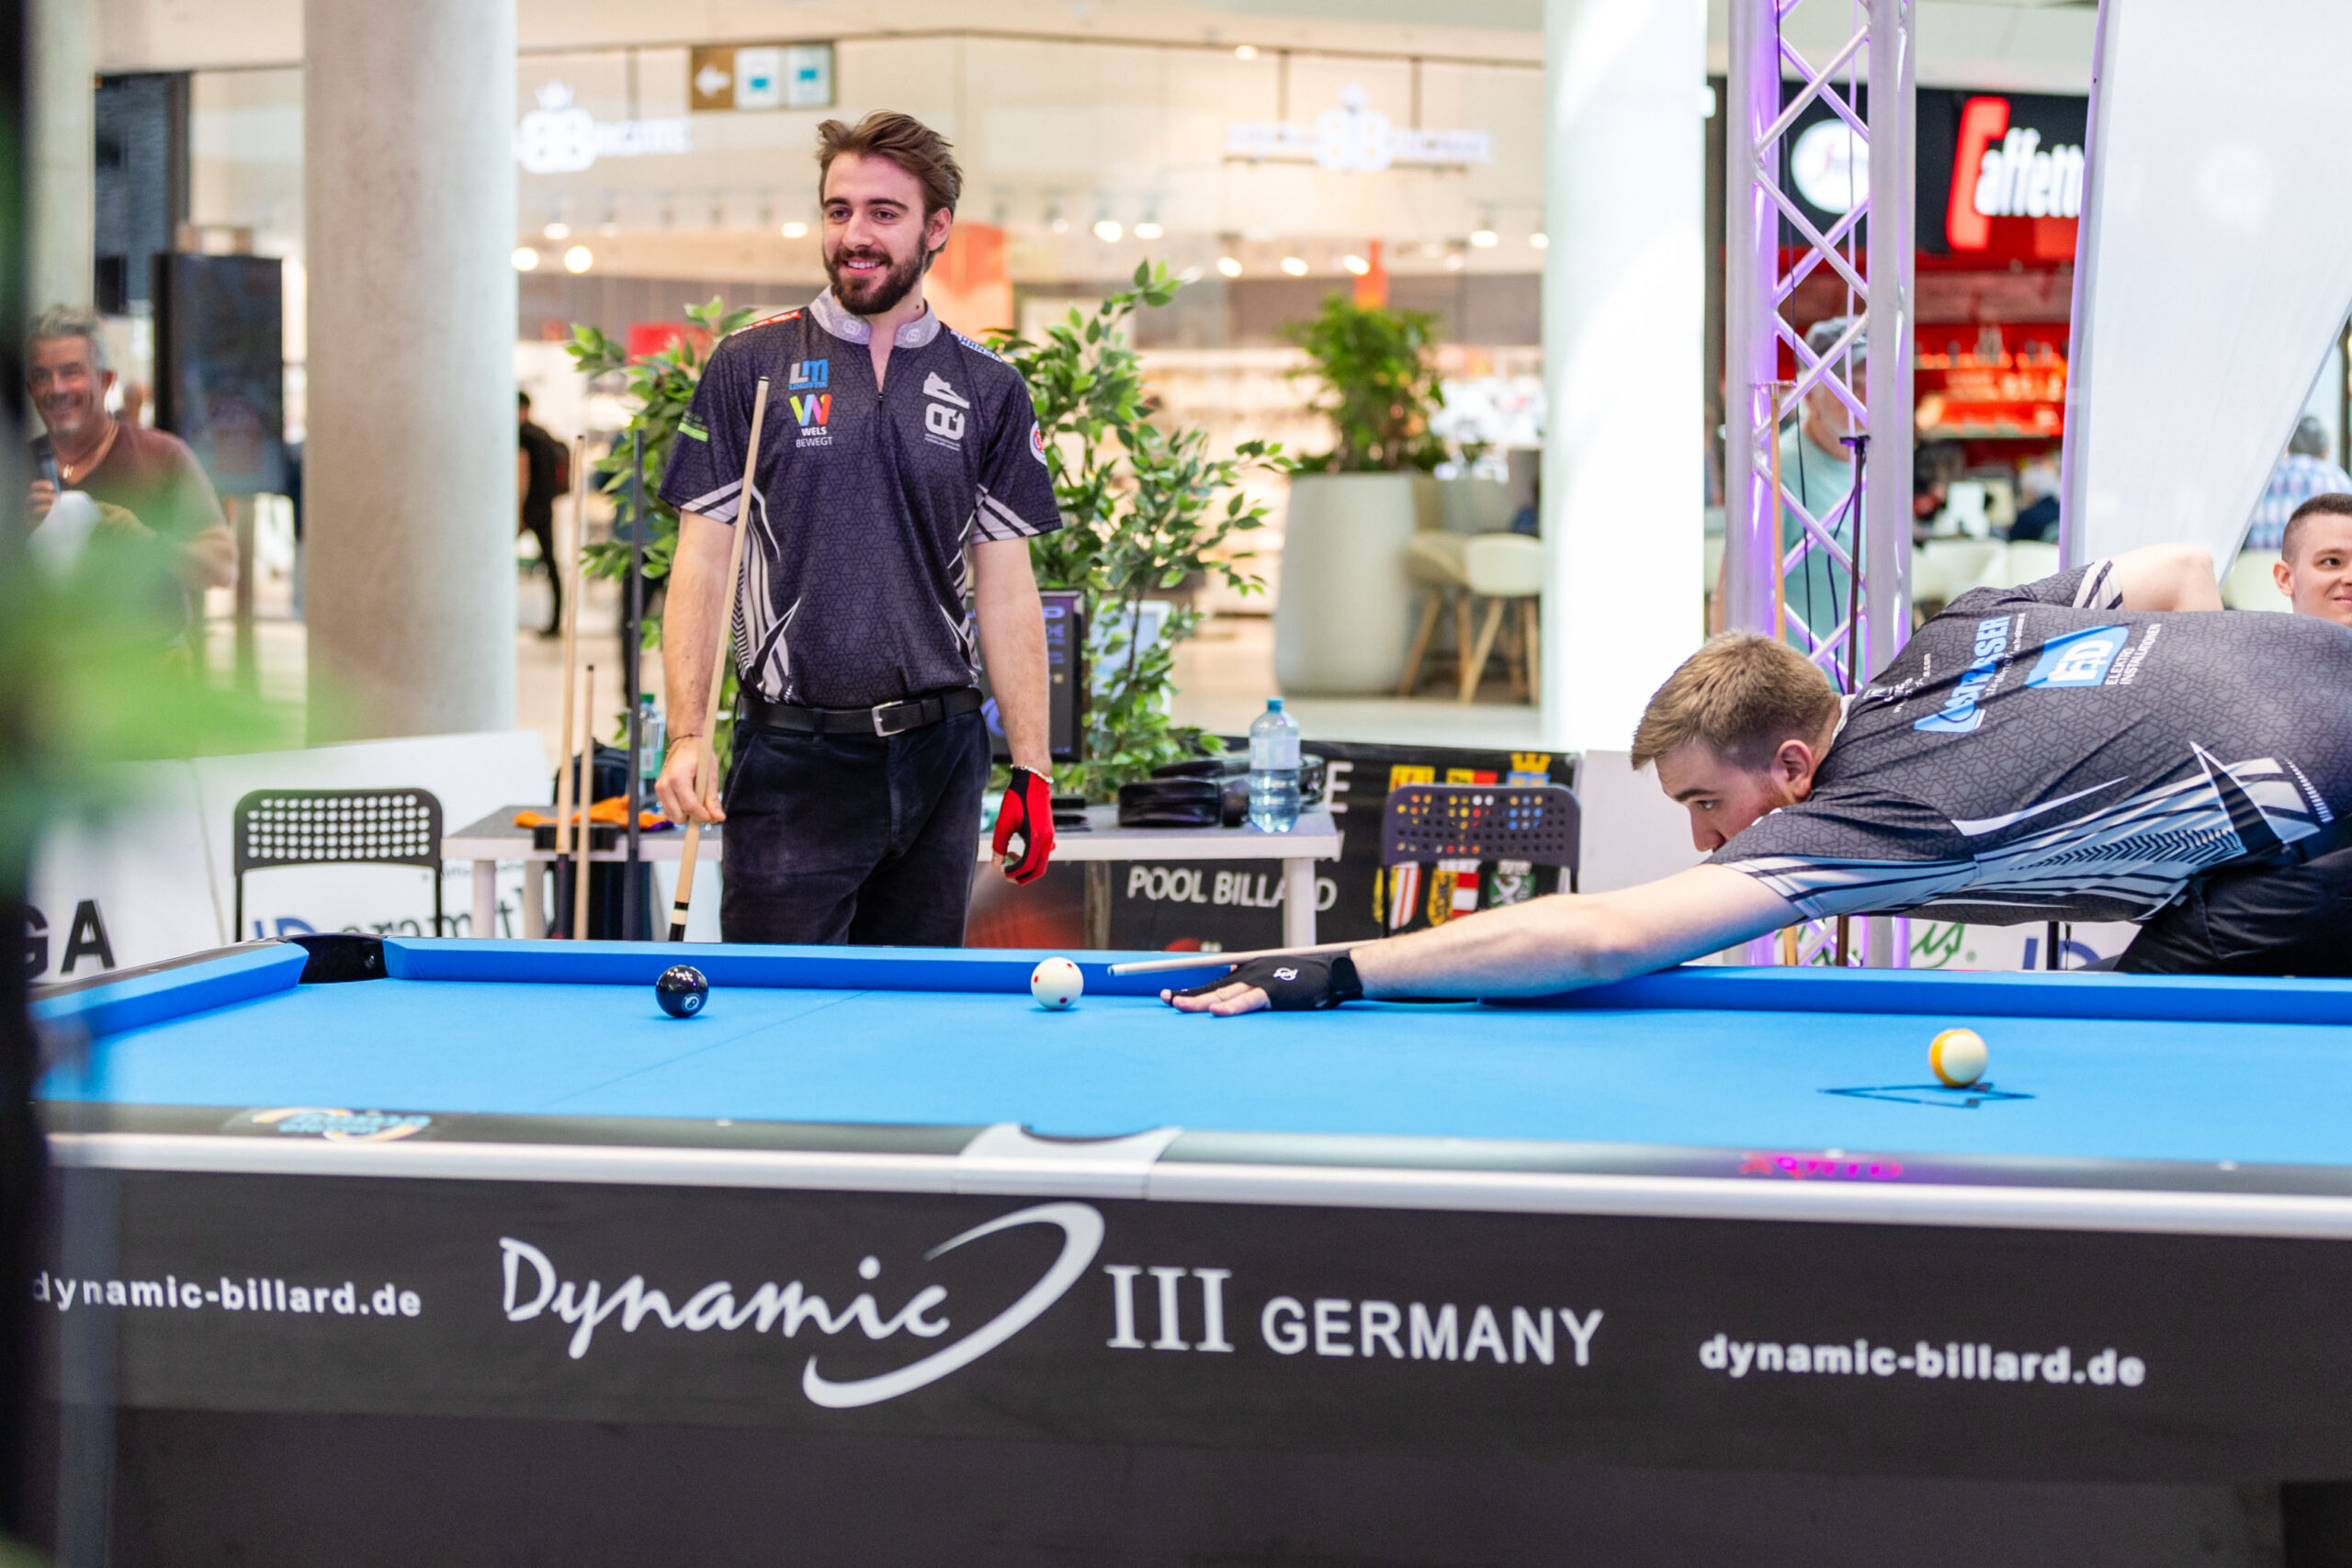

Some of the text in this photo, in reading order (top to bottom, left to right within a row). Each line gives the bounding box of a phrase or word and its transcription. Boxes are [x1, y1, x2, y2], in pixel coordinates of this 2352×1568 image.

[1946, 96, 2084, 251] Caffett
[796, 436, 832, 448] BEWEGT
[801, 426, 827, 436] WELS
[1127, 865, 1338, 911] POOL BILLAD
[33, 1270, 423, 1317] dynamic-billard.de
[499, 1236, 1604, 1367] Dynamic III GERMANY
[1699, 1333, 2146, 1387] dynamic-billard.de
